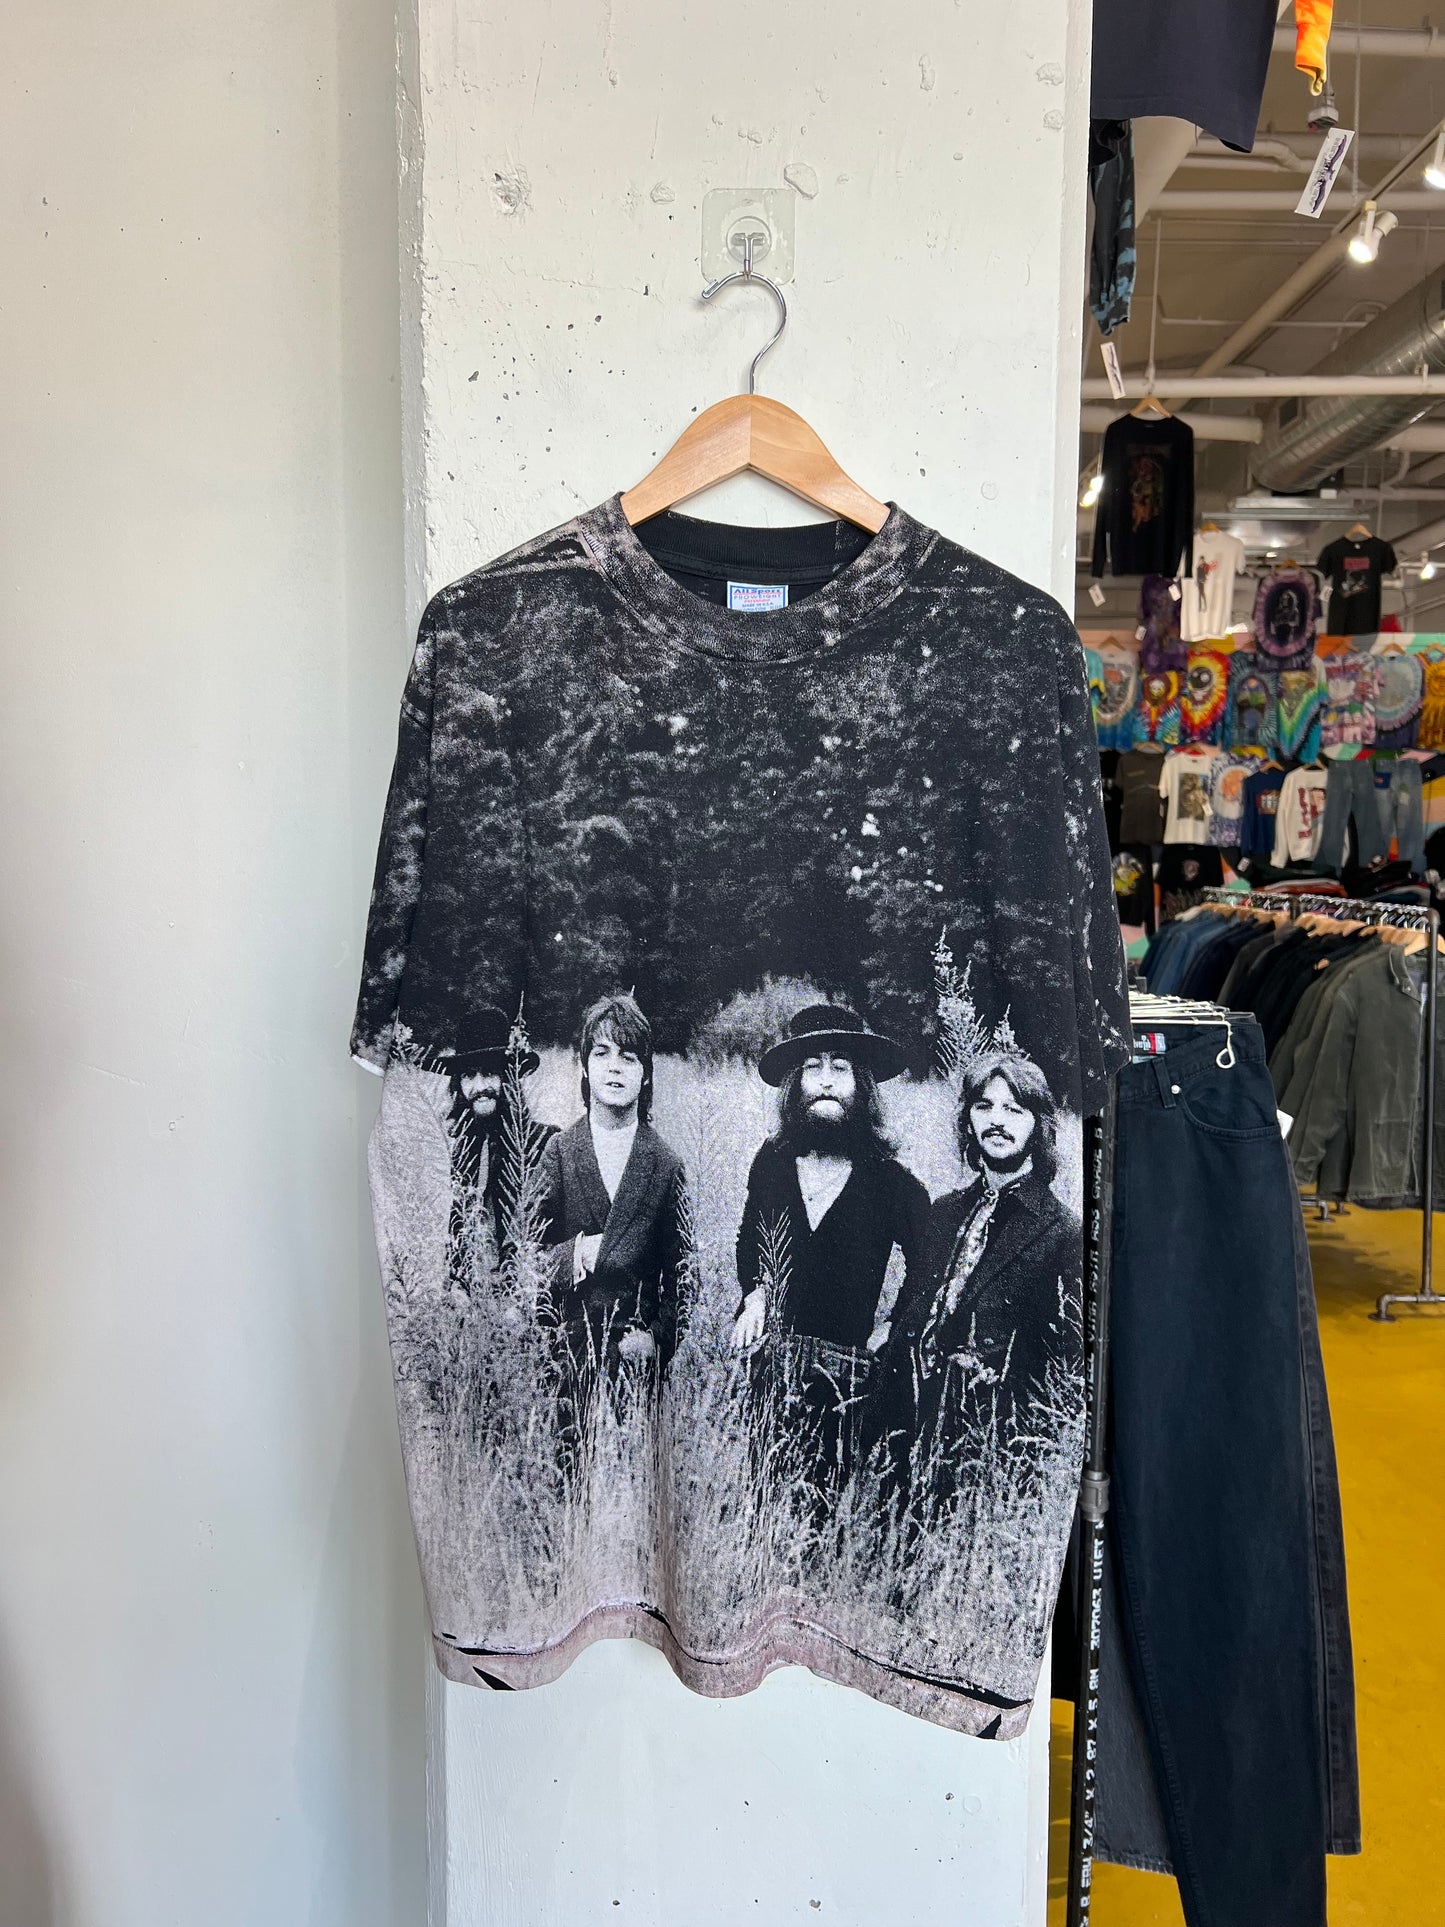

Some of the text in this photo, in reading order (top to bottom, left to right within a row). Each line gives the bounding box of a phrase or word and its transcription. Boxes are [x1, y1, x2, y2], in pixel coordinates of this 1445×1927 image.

[1091, 1148, 1102, 1200] GRADE
[1087, 1717, 1098, 1731] X
[1084, 1788, 1096, 1801] X
